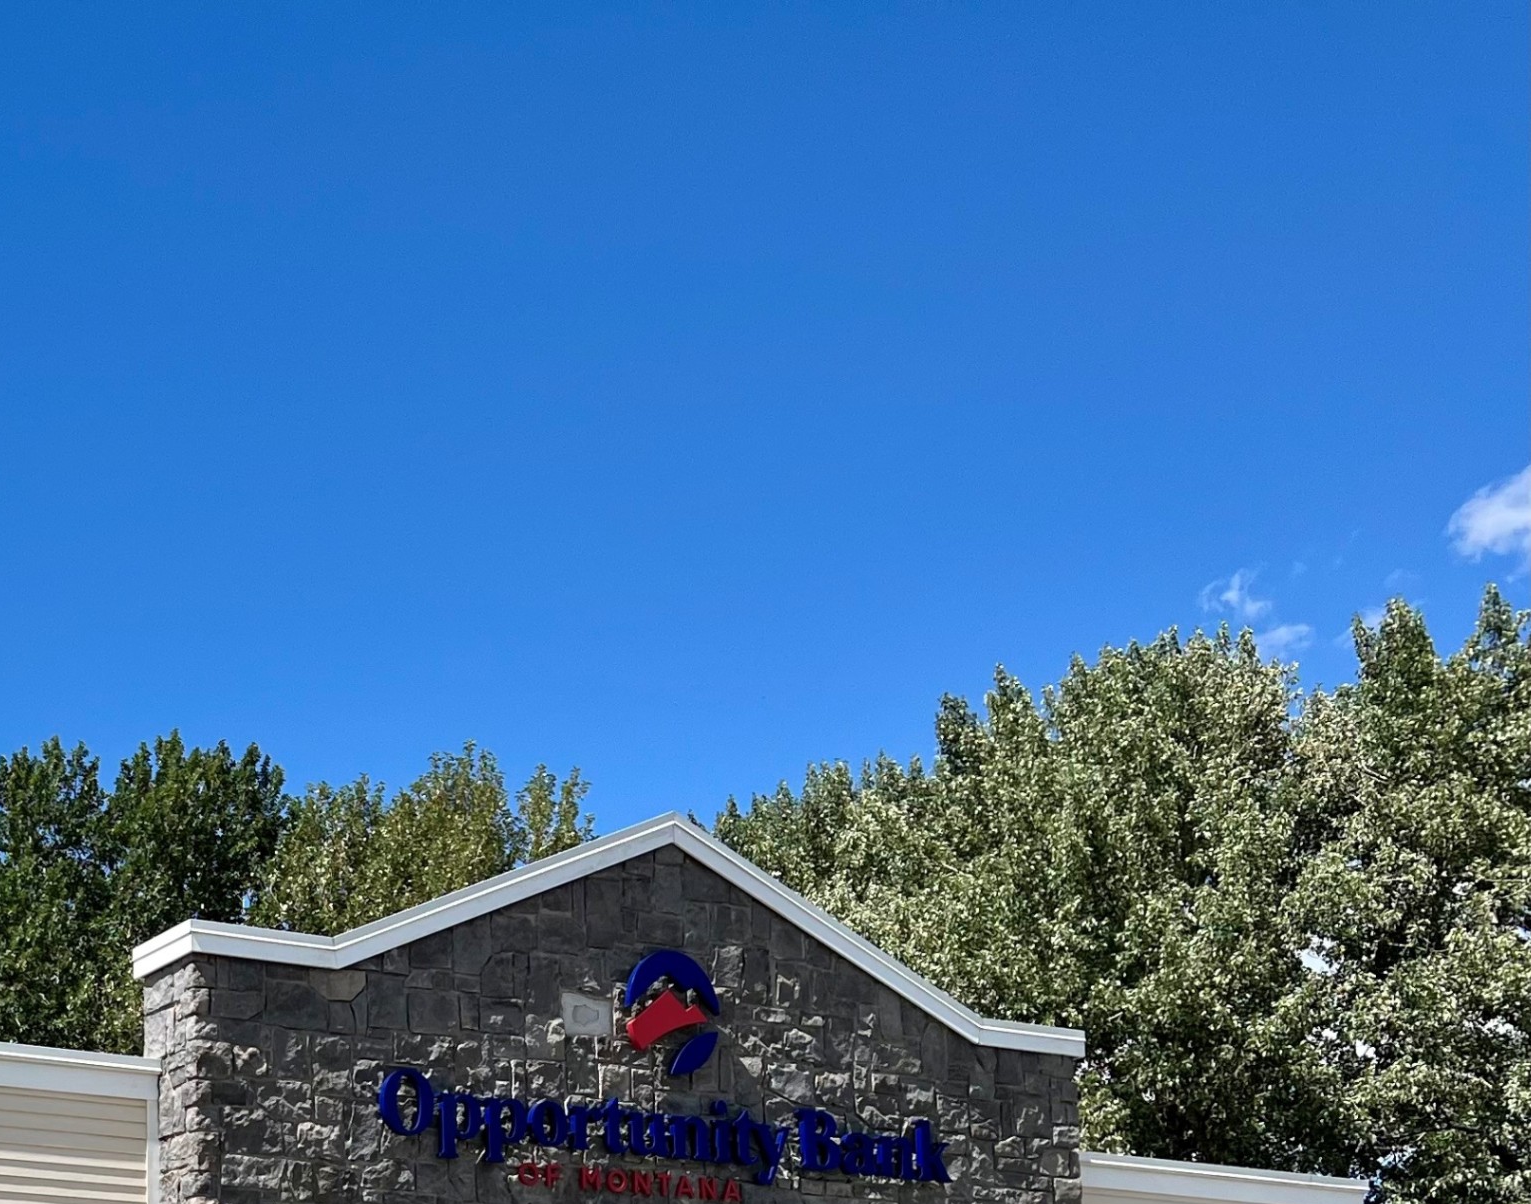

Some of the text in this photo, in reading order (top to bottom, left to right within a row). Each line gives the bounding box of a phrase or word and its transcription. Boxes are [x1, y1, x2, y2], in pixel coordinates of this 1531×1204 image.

[377, 1066, 952, 1185] Opportunity Bank
[518, 1161, 743, 1203] OF MONTANA
